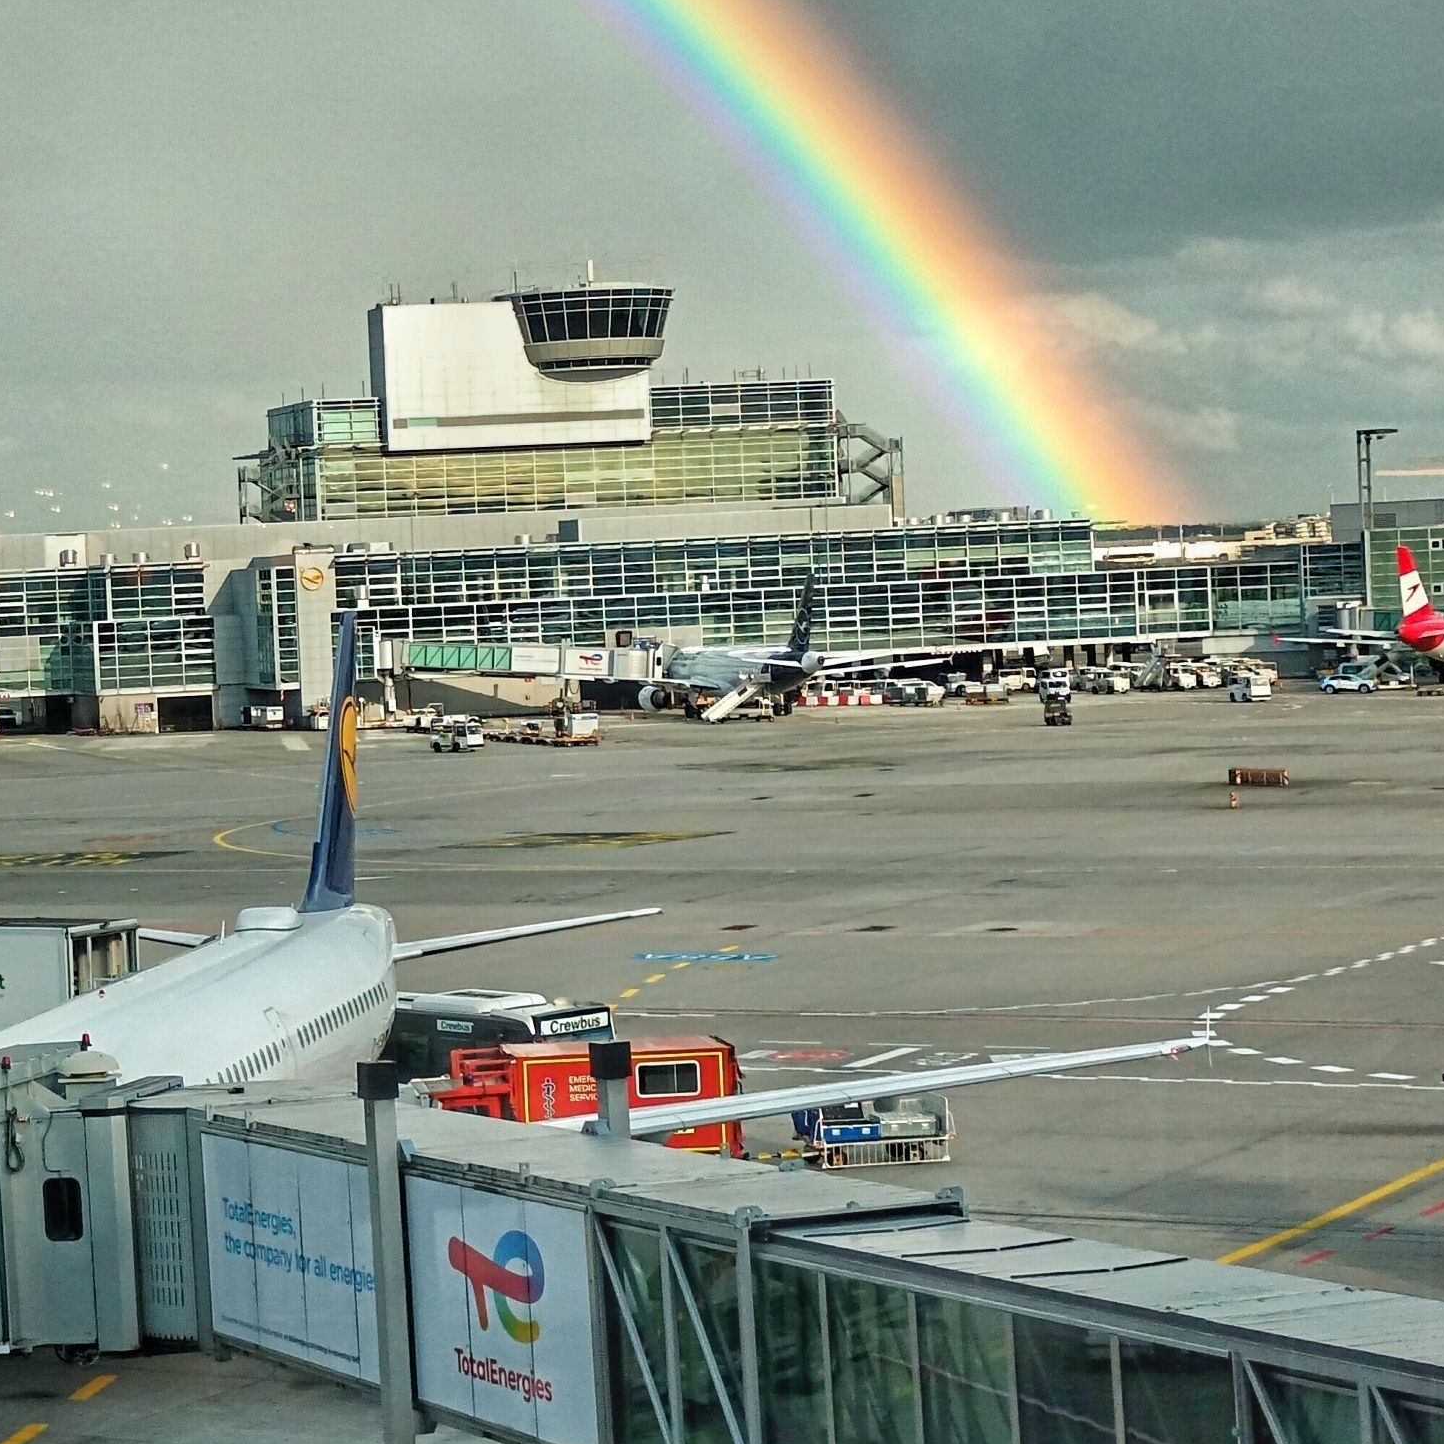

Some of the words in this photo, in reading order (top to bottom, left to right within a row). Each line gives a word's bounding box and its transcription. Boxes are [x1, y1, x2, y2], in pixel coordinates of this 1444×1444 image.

[440, 1020, 472, 1033] Crewbus
[550, 1014, 601, 1034] Crewbus
[569, 1084, 596, 1094] MEDIC
[222, 1196, 296, 1239] TotalEnergies,
[224, 1230, 242, 1255] the
[243, 1240, 293, 1273] company
[294, 1248, 312, 1275] for
[313, 1255, 327, 1279] all
[453, 1347, 553, 1403] TotalEnergies
